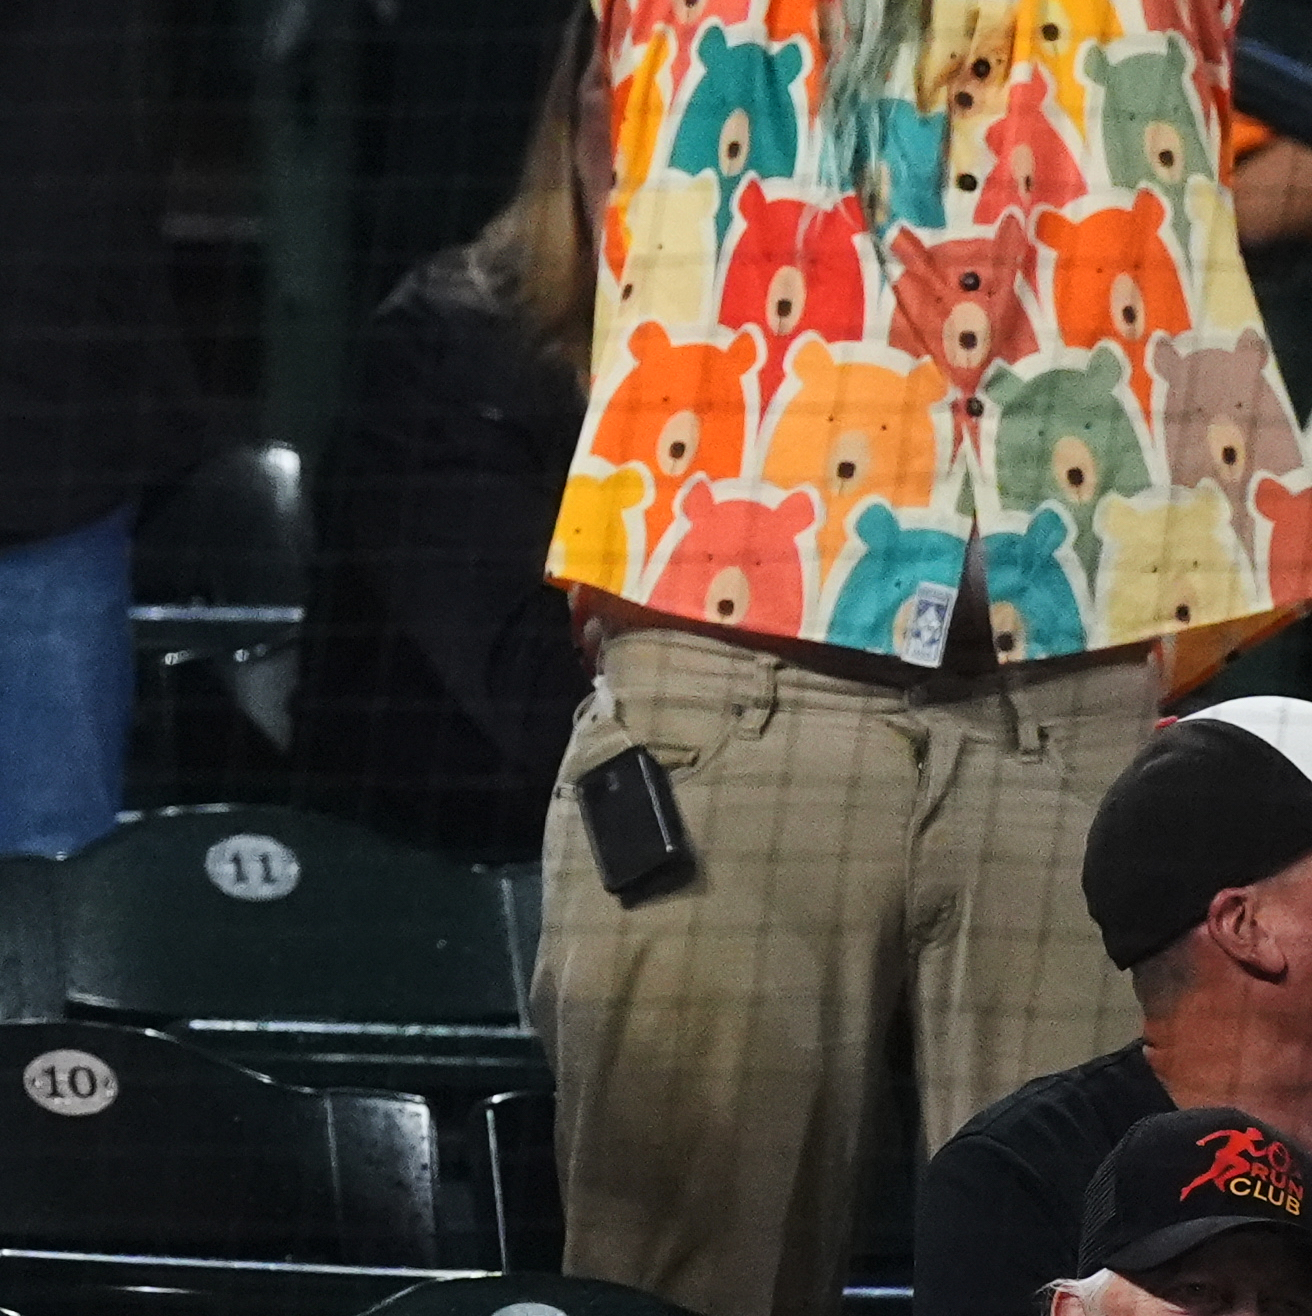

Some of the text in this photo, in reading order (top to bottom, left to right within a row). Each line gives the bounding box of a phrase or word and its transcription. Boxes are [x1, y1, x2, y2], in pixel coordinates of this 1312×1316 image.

[230, 852, 277, 884] 11
[43, 1066, 97, 1099] 10
[1229, 1177, 1302, 1216] CLUB
[1250, 1162, 1304, 1201] RUN
